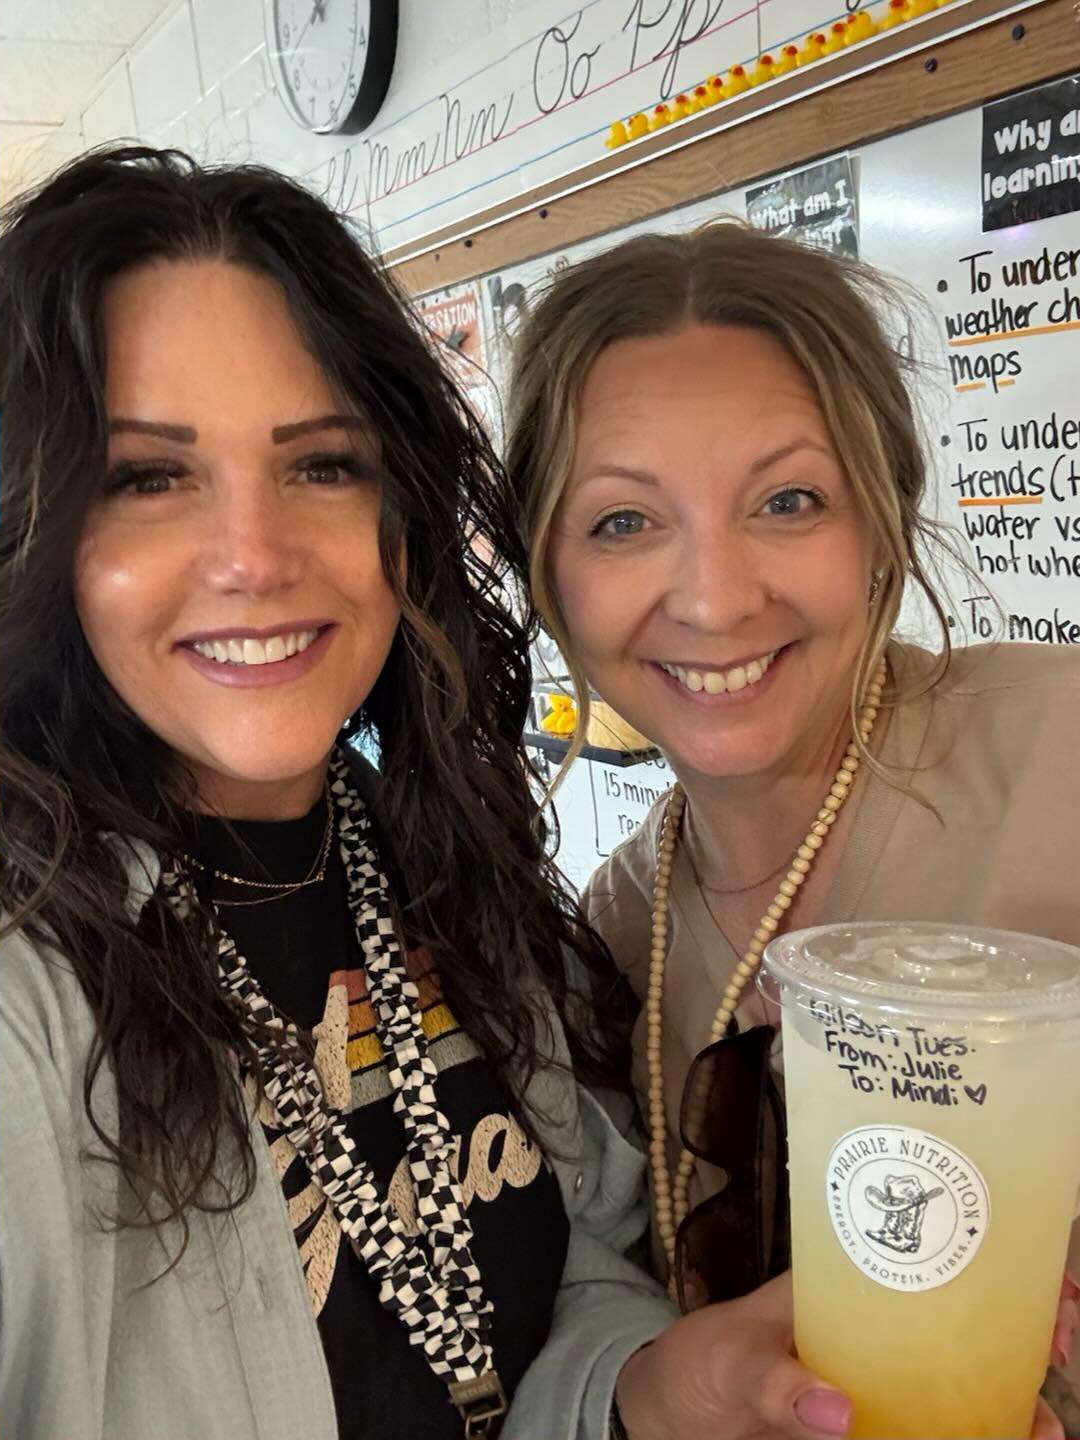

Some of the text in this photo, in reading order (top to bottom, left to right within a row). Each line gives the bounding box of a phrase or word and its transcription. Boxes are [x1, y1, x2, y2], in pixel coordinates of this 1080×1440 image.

[533, 10, 601, 115] Oo
[993, 109, 1080, 155] Why a
[983, 153, 1080, 203] learnin
[958, 250, 994, 295] To
[944, 297, 1039, 340] weather
[948, 350, 1022, 394] maps
[957, 411, 1080, 453] To unde
[951, 459, 1046, 499] trends
[963, 504, 1041, 542] water
[975, 539, 1021, 575] hot
[962, 596, 1080, 645] To make
[603, 769, 620, 798] 15
[824, 1030, 963, 1080] From: Julie
[906, 1026, 976, 1057] Tues.
[837, 1063, 959, 1106] To: Mindi
[833, 1137, 981, 1220] PRAIRIE NUTRITION
